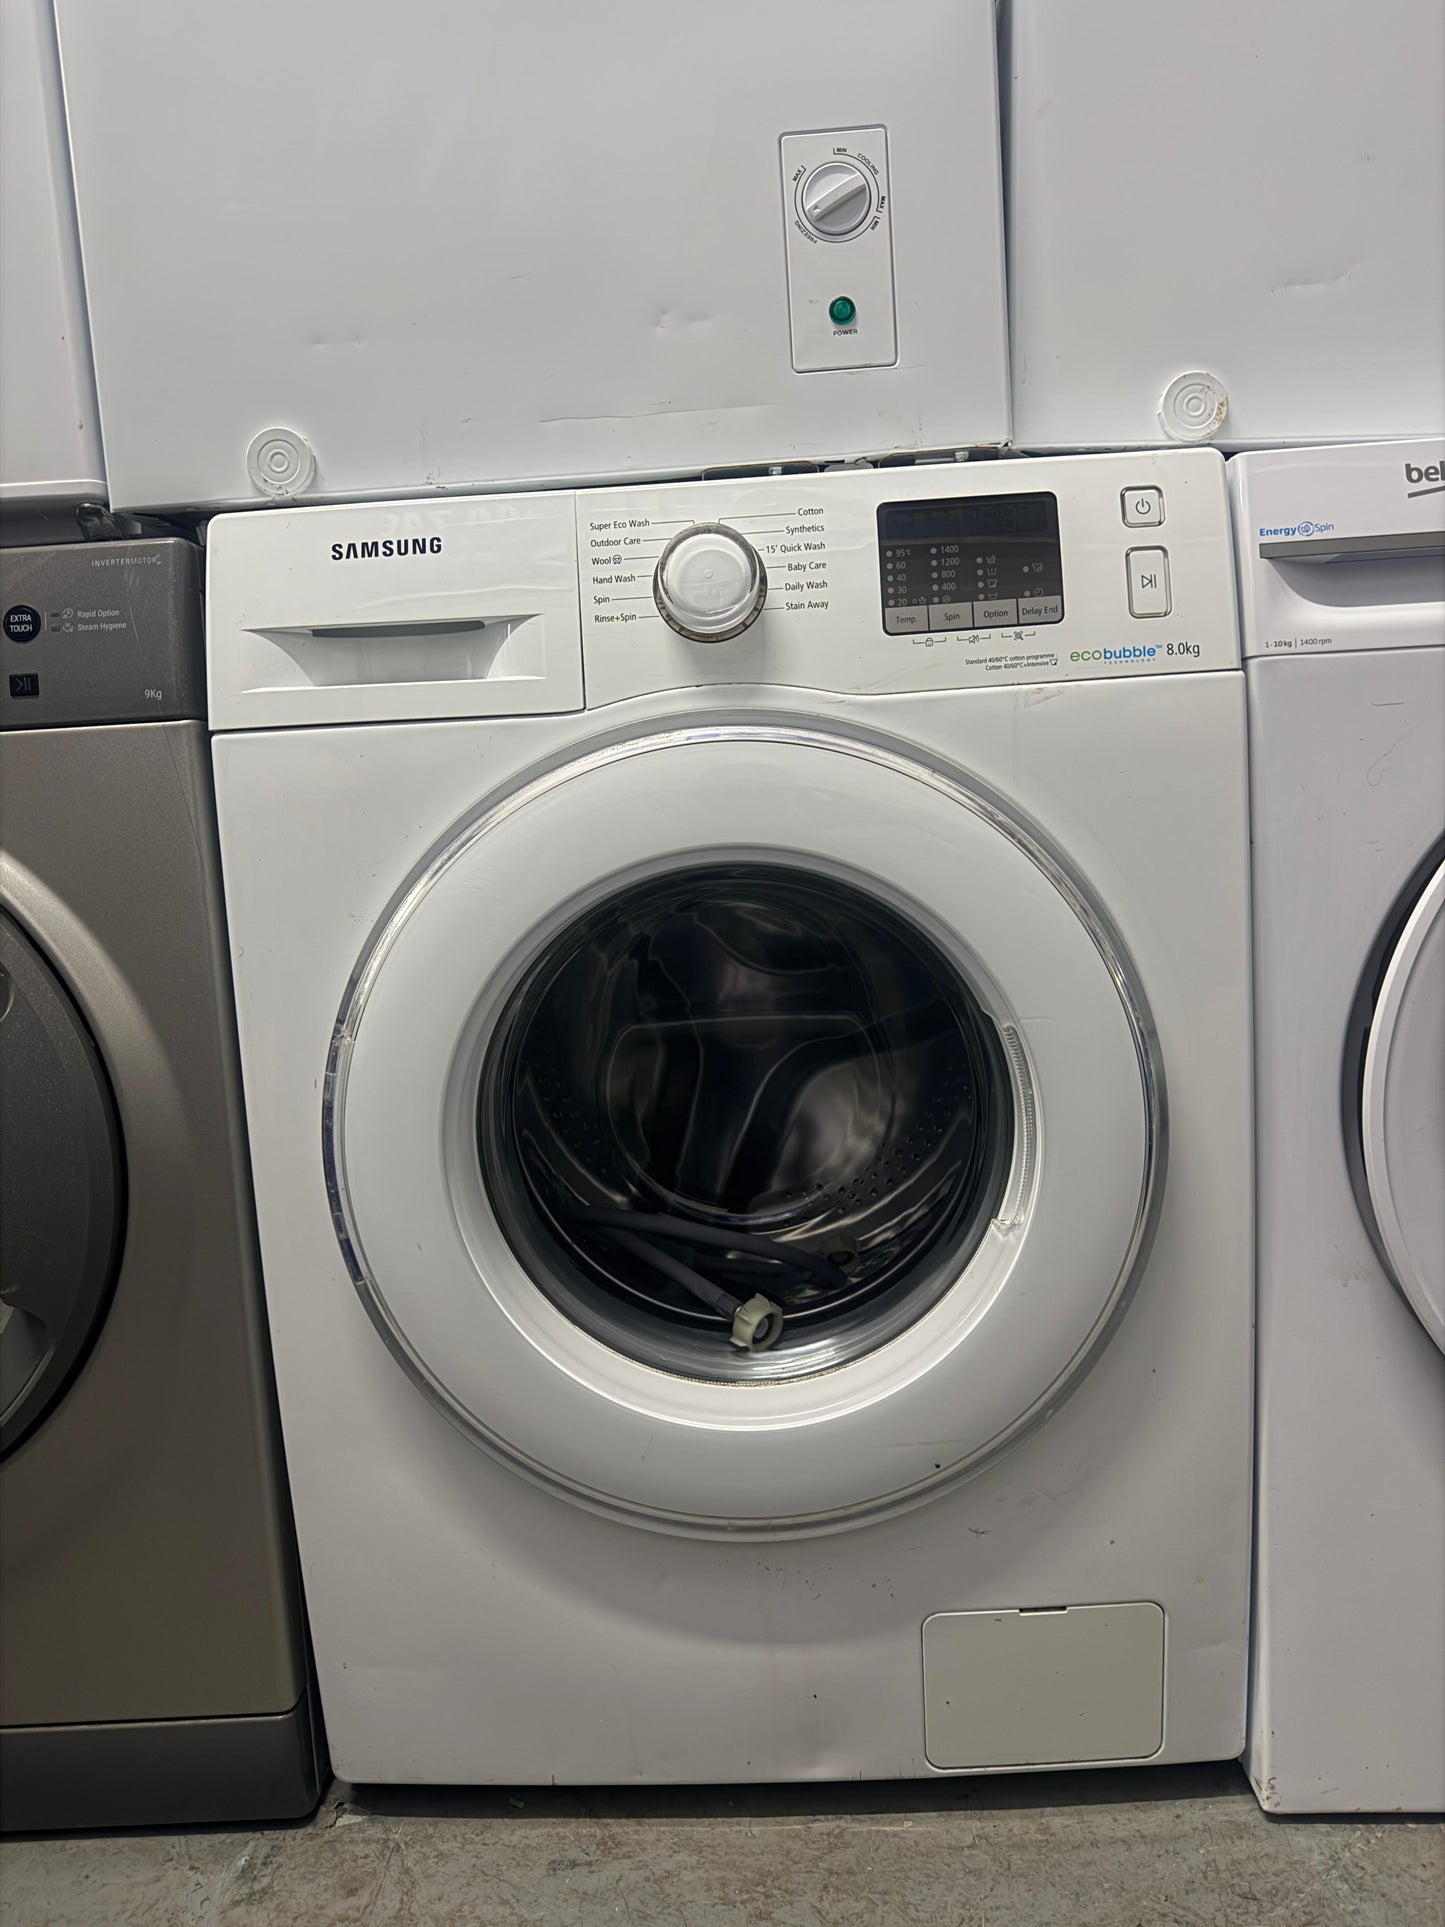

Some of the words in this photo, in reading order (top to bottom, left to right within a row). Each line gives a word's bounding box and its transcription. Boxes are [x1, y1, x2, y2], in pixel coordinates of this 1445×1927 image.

[857, 153, 879, 175] COOLING
[792, 169, 802, 182] MAX
[870, 220, 880, 231] MIN
[794, 220, 818, 244] FREEZING
[832, 328, 858, 336] POWER
[798, 508, 824, 516] Cotton
[590, 522, 611, 532] Super
[613, 520, 627, 529] Eco
[629, 518, 650, 528] Wash
[786, 524, 825, 535] Synthetics
[1259, 527, 1296, 536] Energy
[1314, 523, 1334, 533] Spin
[590, 538, 621, 547] Outdoor
[623, 537, 641, 545] Care
[331, 537, 442, 560] SAMSUNG
[780, 543, 802, 553] Quick
[804, 542, 826, 550] Wash
[941, 545, 959, 554] 1400
[591, 556, 611, 565] Wool
[896, 561, 906, 570] 60
[941, 557, 960, 566] 1200
[787, 562, 807, 572] Baby
[809, 561, 827, 570] Care
[593, 575, 612, 584] Hand
[614, 574, 636, 583] Wash
[897, 573, 906, 582] 40
[941, 570, 956, 578] 800
[785, 582, 804, 592] Daily
[806, 580, 828, 589] Wash
[897, 586, 907, 594] 30
[941, 582, 956, 590] 400
[593, 595, 610, 605] Spin
[898, 598, 907, 606] 20
[786, 601, 805, 610] Stain
[807, 601, 829, 610] Away
[1022, 607, 1042, 616] Delay
[1044, 605, 1058, 614] End
[10, 614, 32, 623] EXTRA
[77, 610, 96, 619] Rapid
[98, 609, 120, 618] Option
[595, 613, 636, 623] Rinse+Spin
[944, 613, 960, 622] Spin
[983, 610, 1008, 620] Option
[896, 616, 918, 624] Temp.
[10, 624, 32, 632] TOUCH
[77, 623, 99, 631] Steam
[100, 621, 127, 631] Hygiene
[1300, 638, 1318, 646] 1400
[1166, 642, 1200, 657] 8.0kg
[965, 657, 987, 665] Standard
[144, 688, 162, 701] 9Kg
